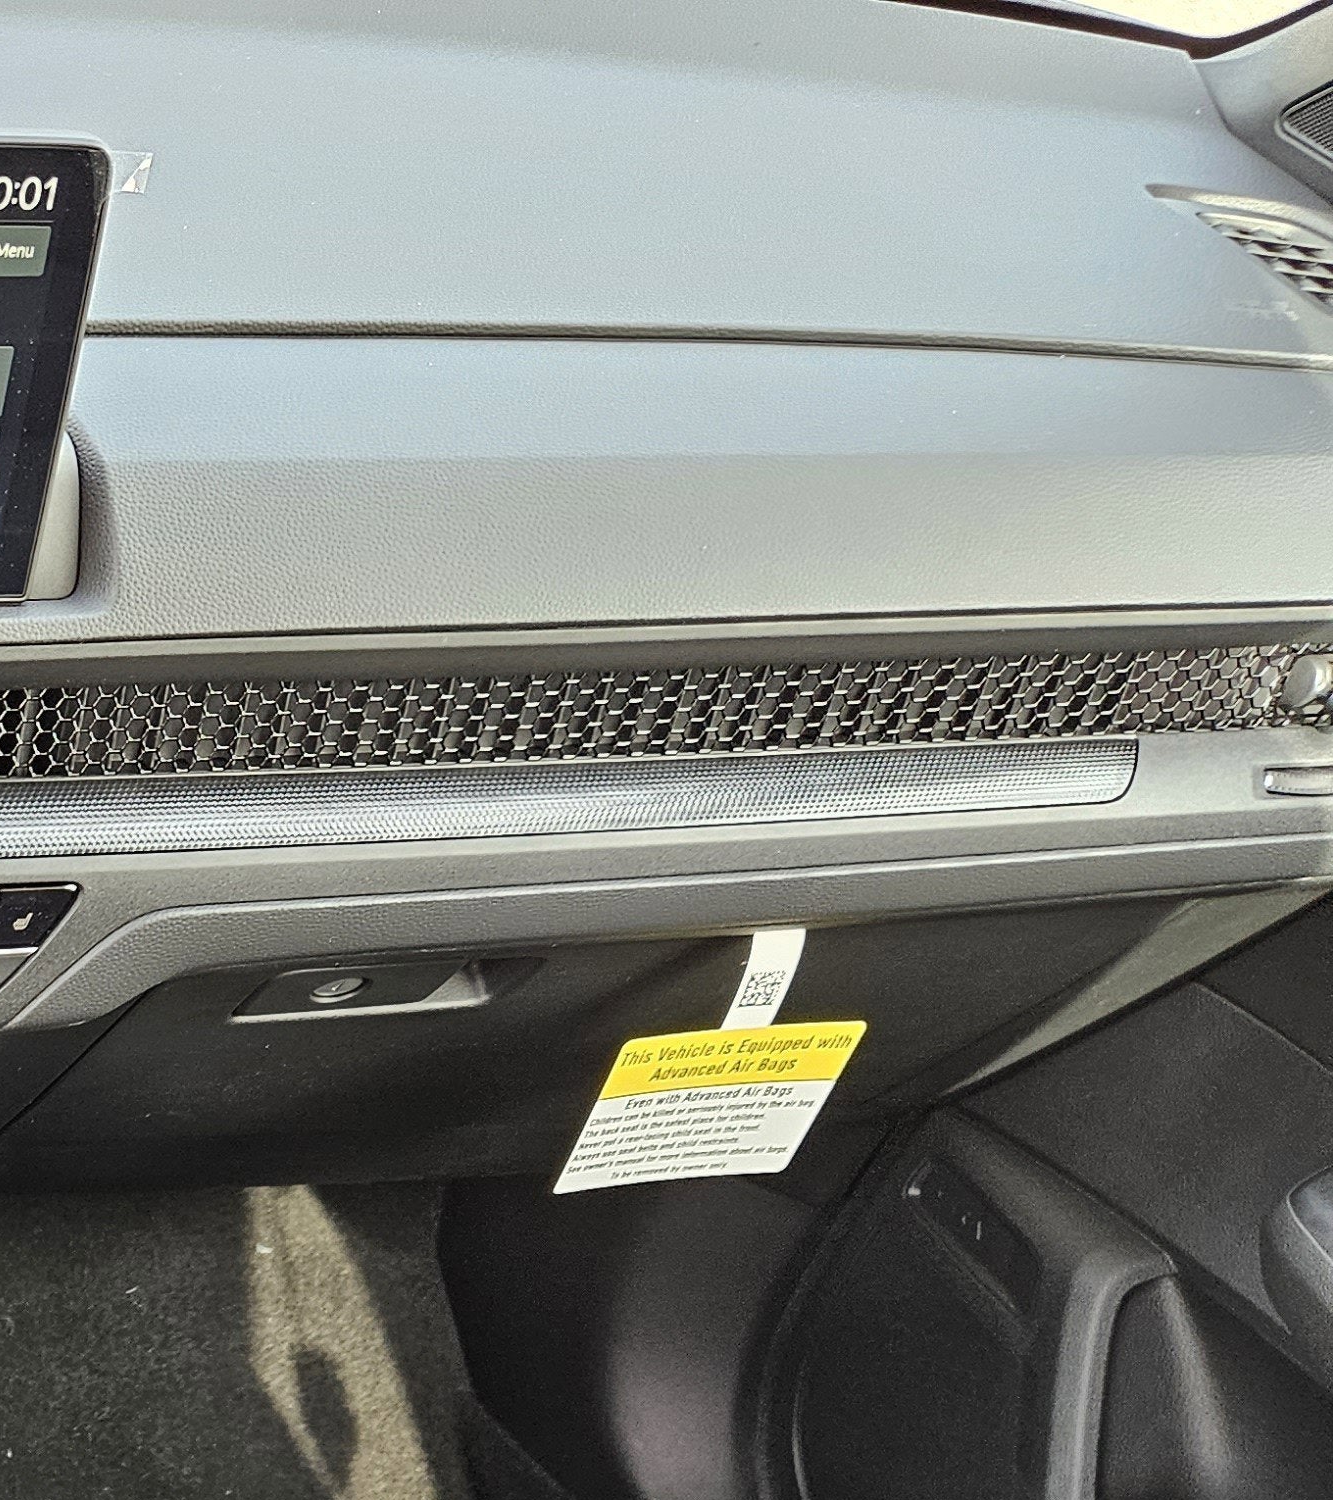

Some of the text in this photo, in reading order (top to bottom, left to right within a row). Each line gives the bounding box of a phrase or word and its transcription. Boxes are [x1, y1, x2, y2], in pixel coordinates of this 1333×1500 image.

[621, 1034, 853, 1067] This Vehicle is Equipped with
[648, 1058, 798, 1082] Advanced Air Bags
[625, 1086, 794, 1110] Even with Advanced Air Bags
